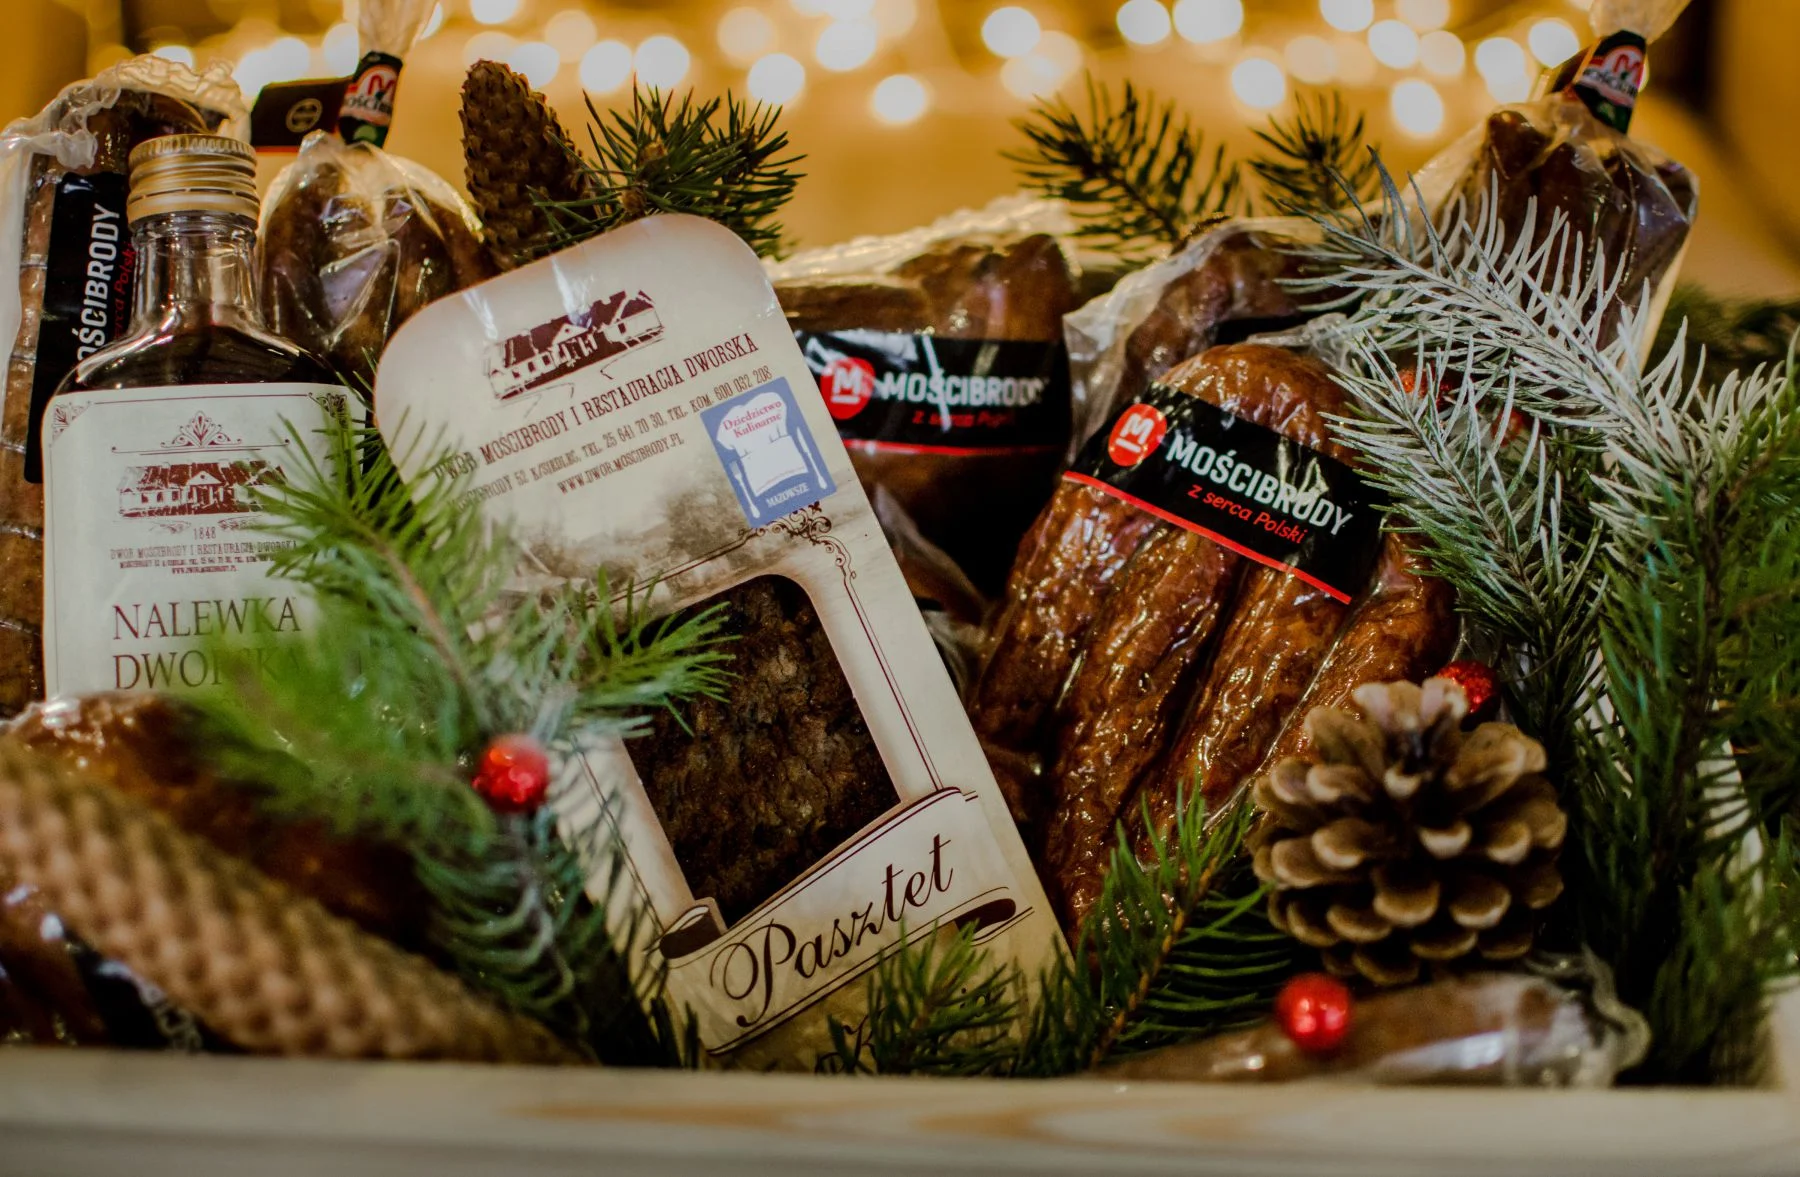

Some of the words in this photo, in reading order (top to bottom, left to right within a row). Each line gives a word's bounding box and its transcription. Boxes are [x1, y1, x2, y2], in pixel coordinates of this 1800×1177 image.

[71, 203, 120, 361] OŚCIBRODY
[570, 405, 582, 426] I
[581, 363, 685, 421] RESTAURACJA
[683, 333, 759, 378] DWORSKA
[602, 431, 619, 449] 25
[617, 424, 636, 442] 641
[634, 417, 650, 435] 70
[713, 382, 732, 401] 600
[732, 374, 754, 394] 032
[752, 365, 774, 385] 208
[723, 400, 783, 431] Dziedzictwo
[733, 413, 782, 438] Kulinarne
[1164, 436, 1354, 536] MOŚCIBRODY
[1187, 483, 1203, 498] z
[1203, 493, 1253, 521] serca
[1253, 511, 1310, 545] Polski
[193, 526, 217, 540] 1848
[112, 596, 302, 641] NALEWKA
[709, 833, 953, 1028] Pasztet
